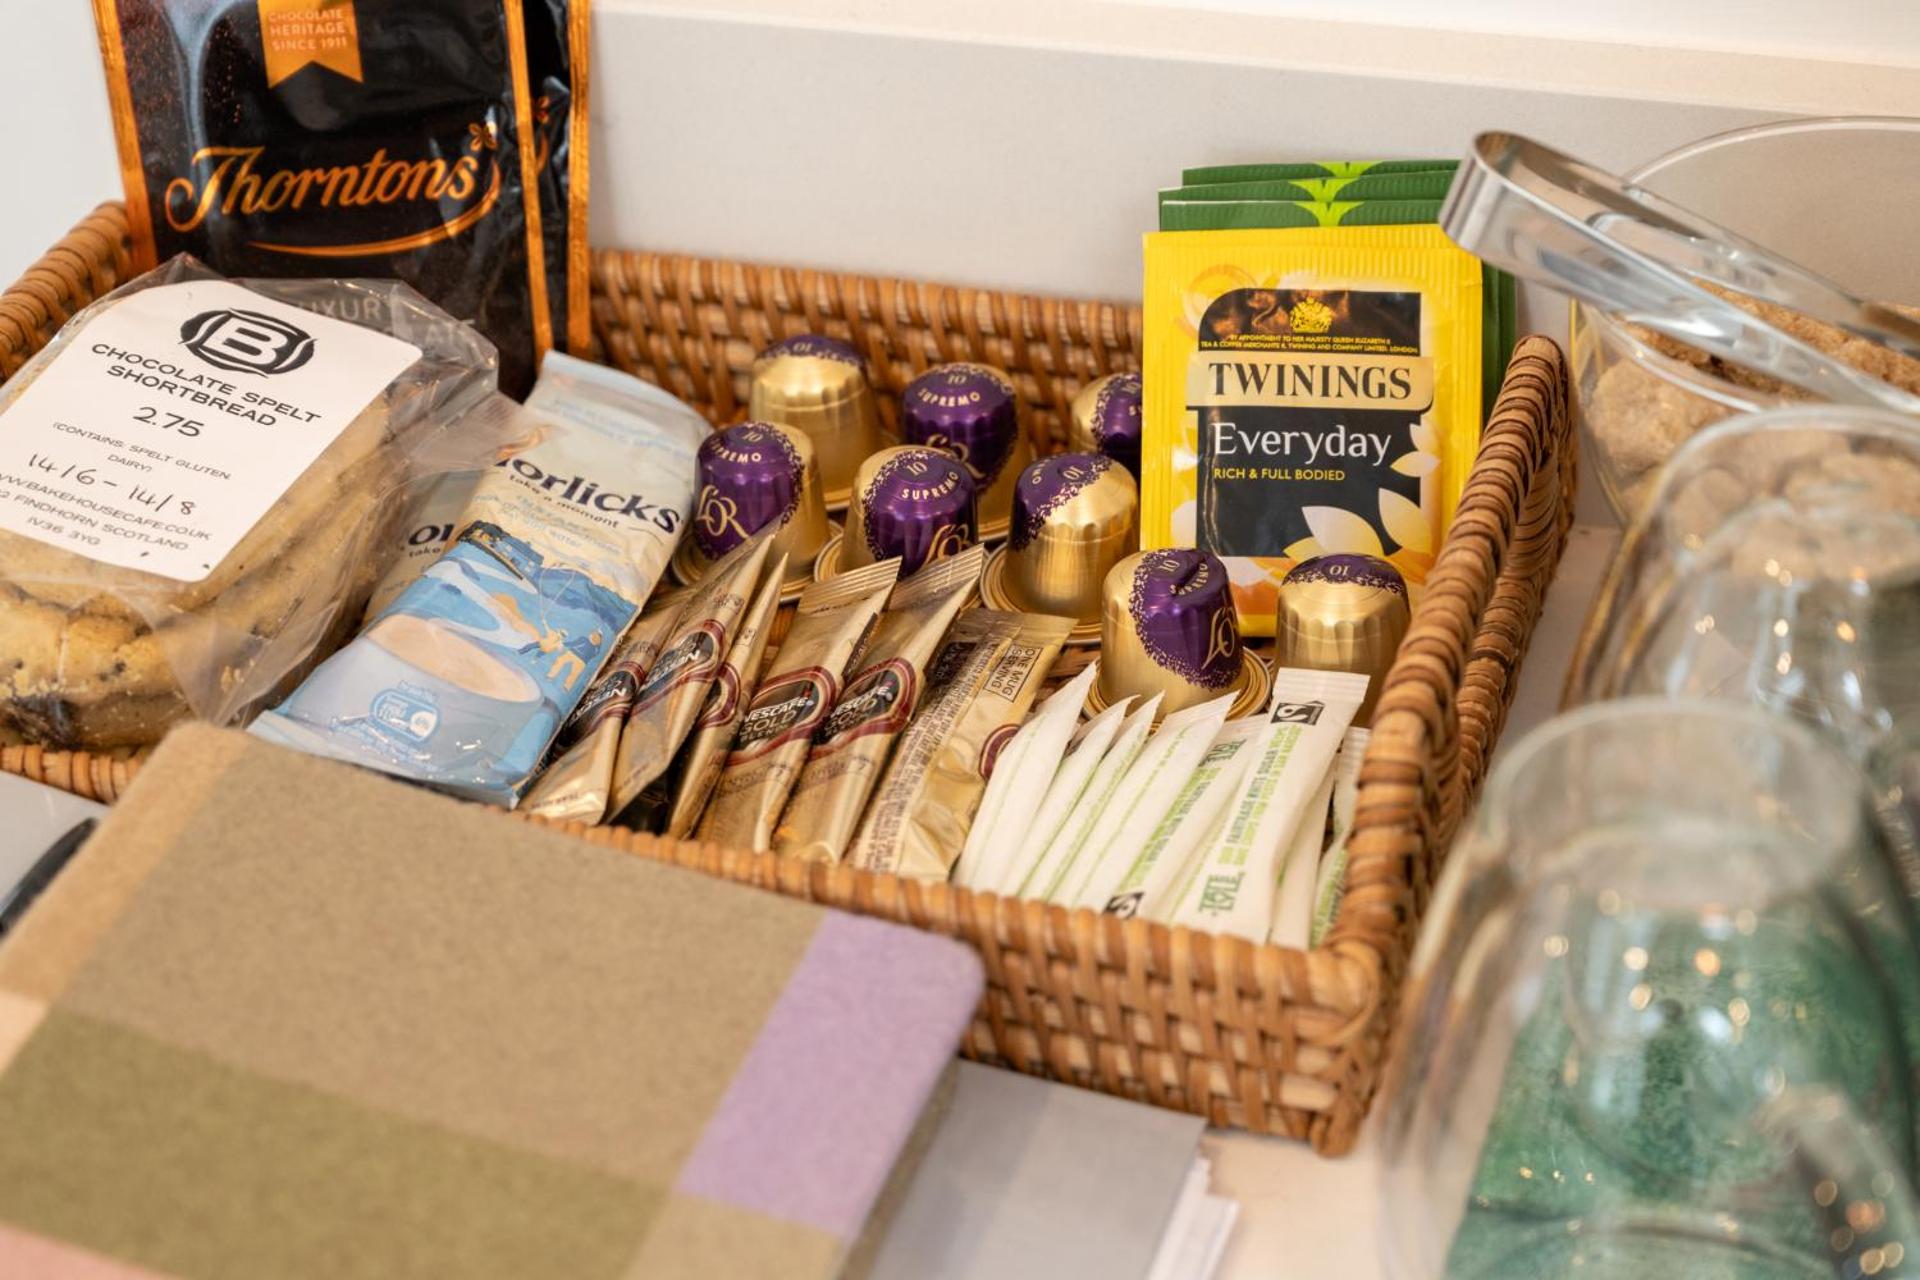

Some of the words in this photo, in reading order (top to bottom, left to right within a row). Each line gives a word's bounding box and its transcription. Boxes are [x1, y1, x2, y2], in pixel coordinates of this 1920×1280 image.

[268, 8, 344, 21] CHOCOLATE
[269, 21, 346, 37] HERITAGE
[271, 37, 317, 52] SINCE
[320, 35, 348, 49] 1911
[165, 146, 478, 232] Thorntons
[91, 343, 237, 396] CHOCOLATE
[240, 391, 322, 424] SPELT
[106, 364, 277, 427] SHORTBREAD
[1208, 361, 1412, 400] TWININGS
[917, 387, 981, 407] SUPREMO
[132, 406, 205, 438] 2.75
[128, 444, 174, 462] SPELT
[1213, 422, 1392, 466] Everyday
[905, 460, 928, 476] 10
[1213, 467, 1245, 480] RICH
[1248, 468, 1258, 480] &
[1261, 468, 1292, 480] FULL
[1295, 468, 1345, 481] BODIED
[496, 456, 681, 534] orlicks
[902, 470, 959, 500] SUPREMO
[508, 474, 541, 494] take
[556, 501, 620, 528] moment
[14, 494, 99, 528] FINDHORN
[101, 522, 189, 551] SCOTLAND
[991, 648, 1023, 689] SERVING
[1018, 648, 1036, 668] ONE
[1001, 670, 1024, 696] MUG
